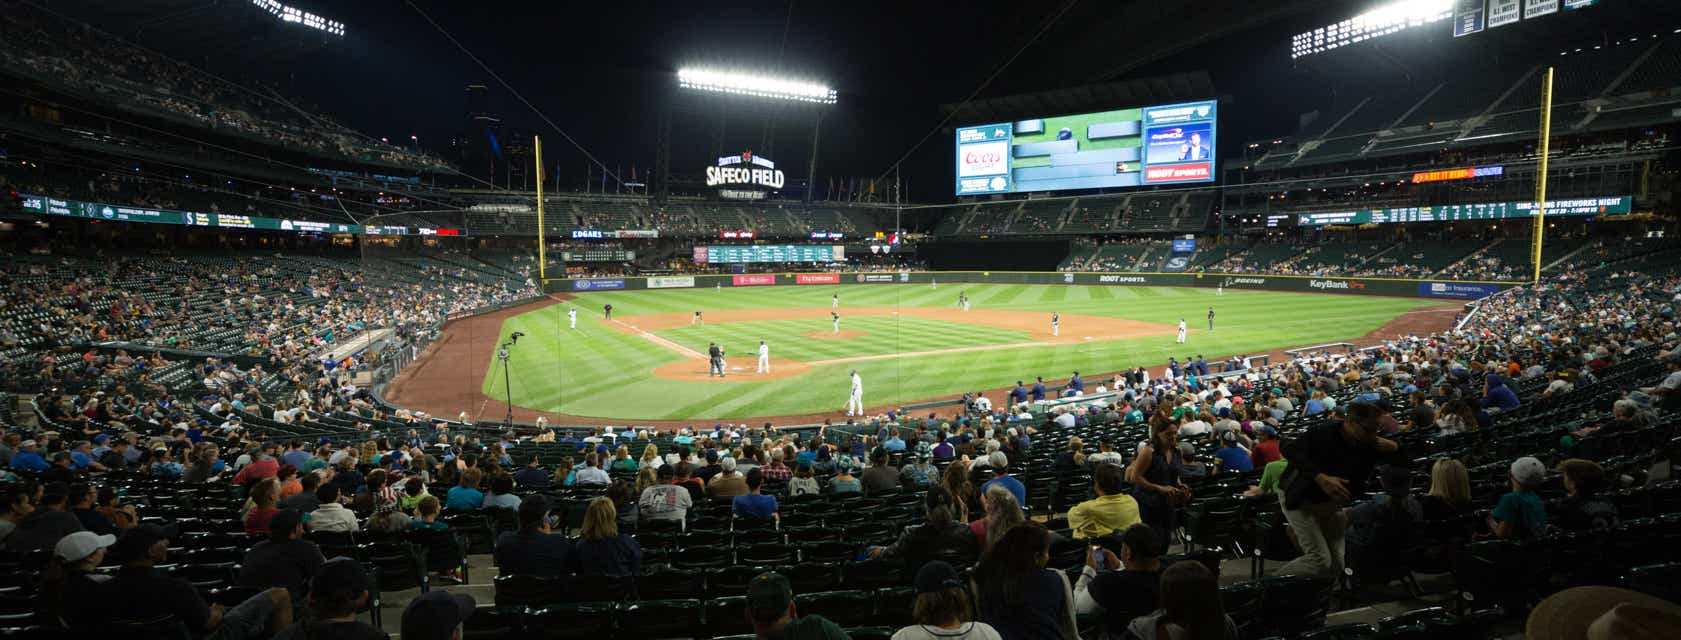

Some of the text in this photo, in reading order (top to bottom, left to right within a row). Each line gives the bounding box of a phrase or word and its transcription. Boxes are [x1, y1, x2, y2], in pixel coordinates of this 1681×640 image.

[1502, 3, 1516, 13] WEST
[1526, 2, 1557, 16] CHAMPIONS
[1490, 12, 1518, 25] CHAMPIONS
[706, 166, 784, 189] SAFECO FIELD
[1147, 168, 1175, 179] ROOT
[1556, 198, 1597, 209] FIREWORKS
[1598, 197, 1621, 206] NIGHT
[1310, 280, 1348, 290] KeyBank
